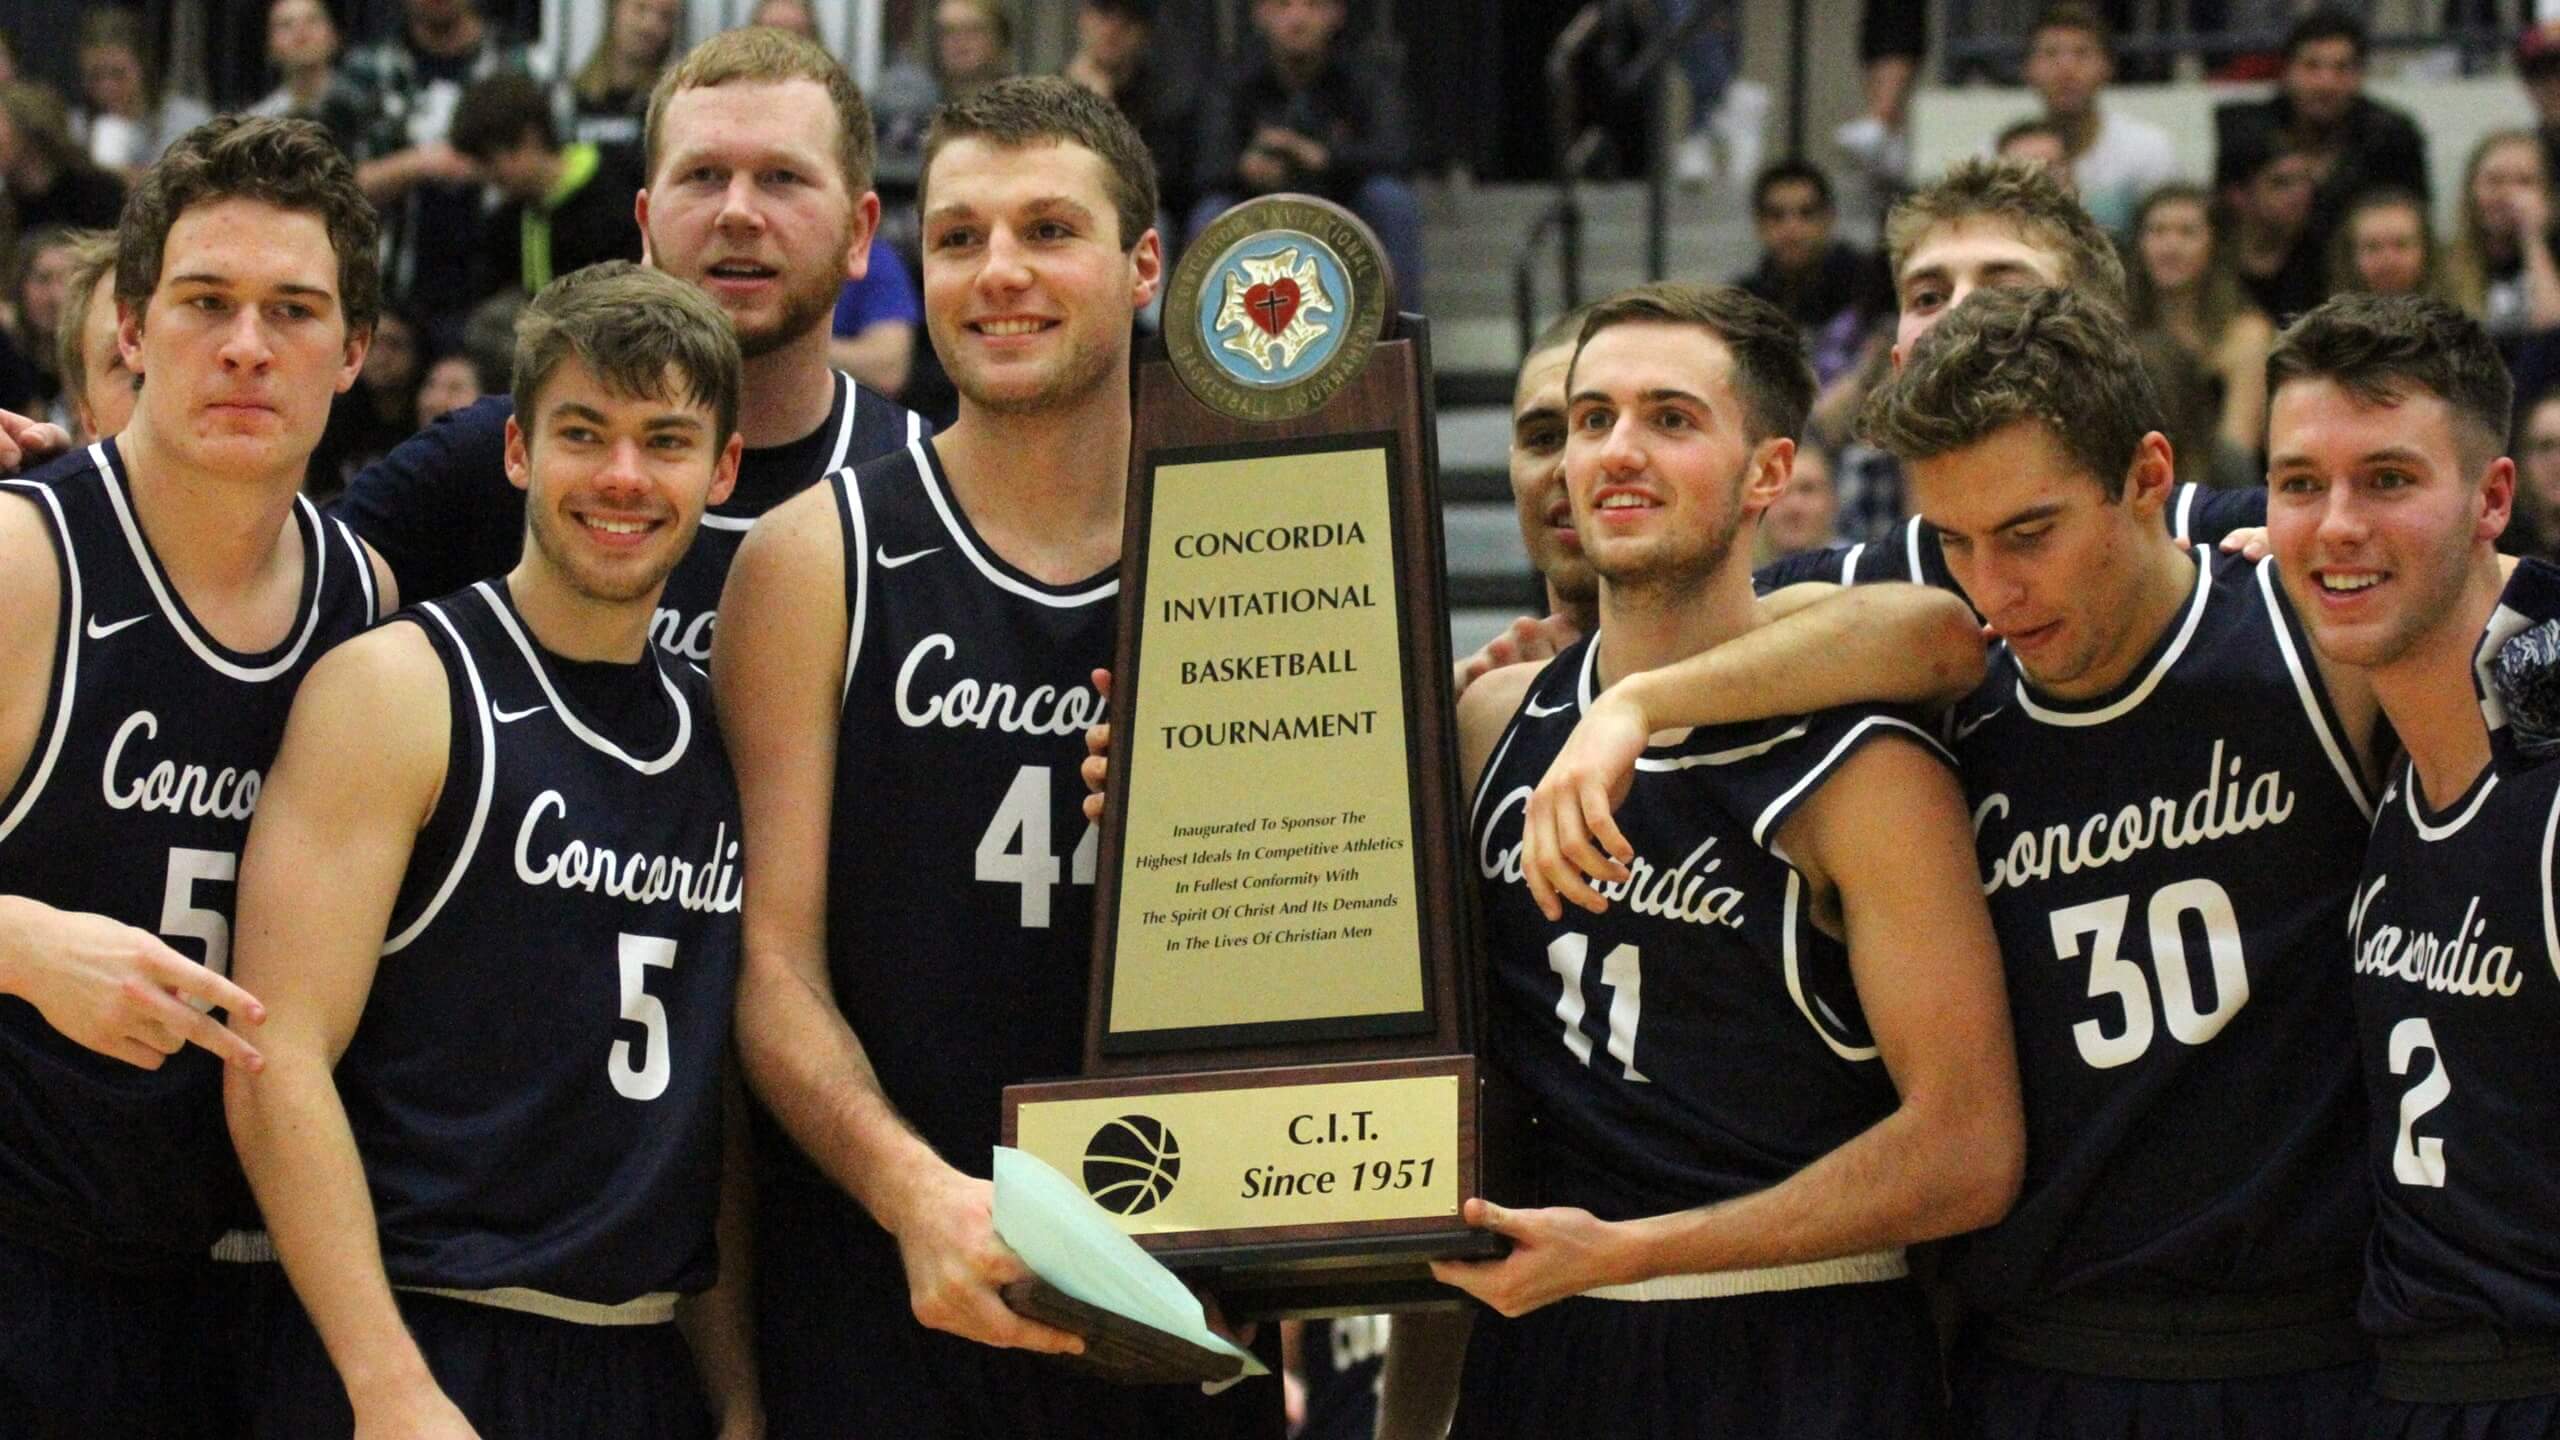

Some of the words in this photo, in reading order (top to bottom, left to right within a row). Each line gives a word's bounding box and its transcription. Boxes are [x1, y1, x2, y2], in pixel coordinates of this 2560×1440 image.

[1260, 206, 1371, 279] INVITATIONAL
[1174, 521, 1365, 559] CONCORDIA
[1164, 584, 1376, 623] INVITATIONAL
[896, 633, 1109, 735] Conco
[1181, 649, 1357, 685] BASKETBALL
[1161, 710, 1377, 749] TOURNAMENT
[103, 711, 261, 820] Conco
[1173, 818, 1257, 839] Inaugurated
[1262, 818, 1277, 831] To
[1281, 816, 1337, 833] Sponsor
[1342, 810, 1366, 824] The
[1974, 738, 2295, 896] Concordia
[515, 789, 742, 913] Concordi
[1135, 853, 1188, 871] Highest
[1192, 849, 1232, 864] Ideals
[1236, 848, 1251, 861] In
[1254, 841, 1339, 862] Competitive
[1344, 837, 1404, 853] Athletics
[1175, 881, 1189, 894] In
[1193, 877, 1238, 893] Fullest
[1242, 871, 1319, 889] Conformity
[1326, 868, 1359, 883] With
[1143, 911, 1167, 925] The
[1171, 907, 1208, 926] Spirit
[1211, 905, 1232, 920] Of
[1234, 903, 1275, 918] Christ
[1281, 900, 1308, 914] And
[1312, 900, 1328, 913] Its
[1333, 893, 1398, 911] Demands
[1166, 939, 1180, 951] In
[1186, 936, 1210, 950] The
[1214, 935, 1248, 948] Lives
[1252, 931, 1273, 945] Of
[1275, 927, 1337, 943] Christian
[1343, 926, 1372, 938] Men
[2049, 878, 2250, 1069] 30
[608, 932, 678, 1101] 5
[1547, 931, 1651, 1083] 11
[2389, 1017, 2452, 1188] 2
[1288, 1110, 1378, 1145] C.I.T.
[1241, 1165, 1335, 1199] Since
[1353, 1158, 1434, 1191] 1951
